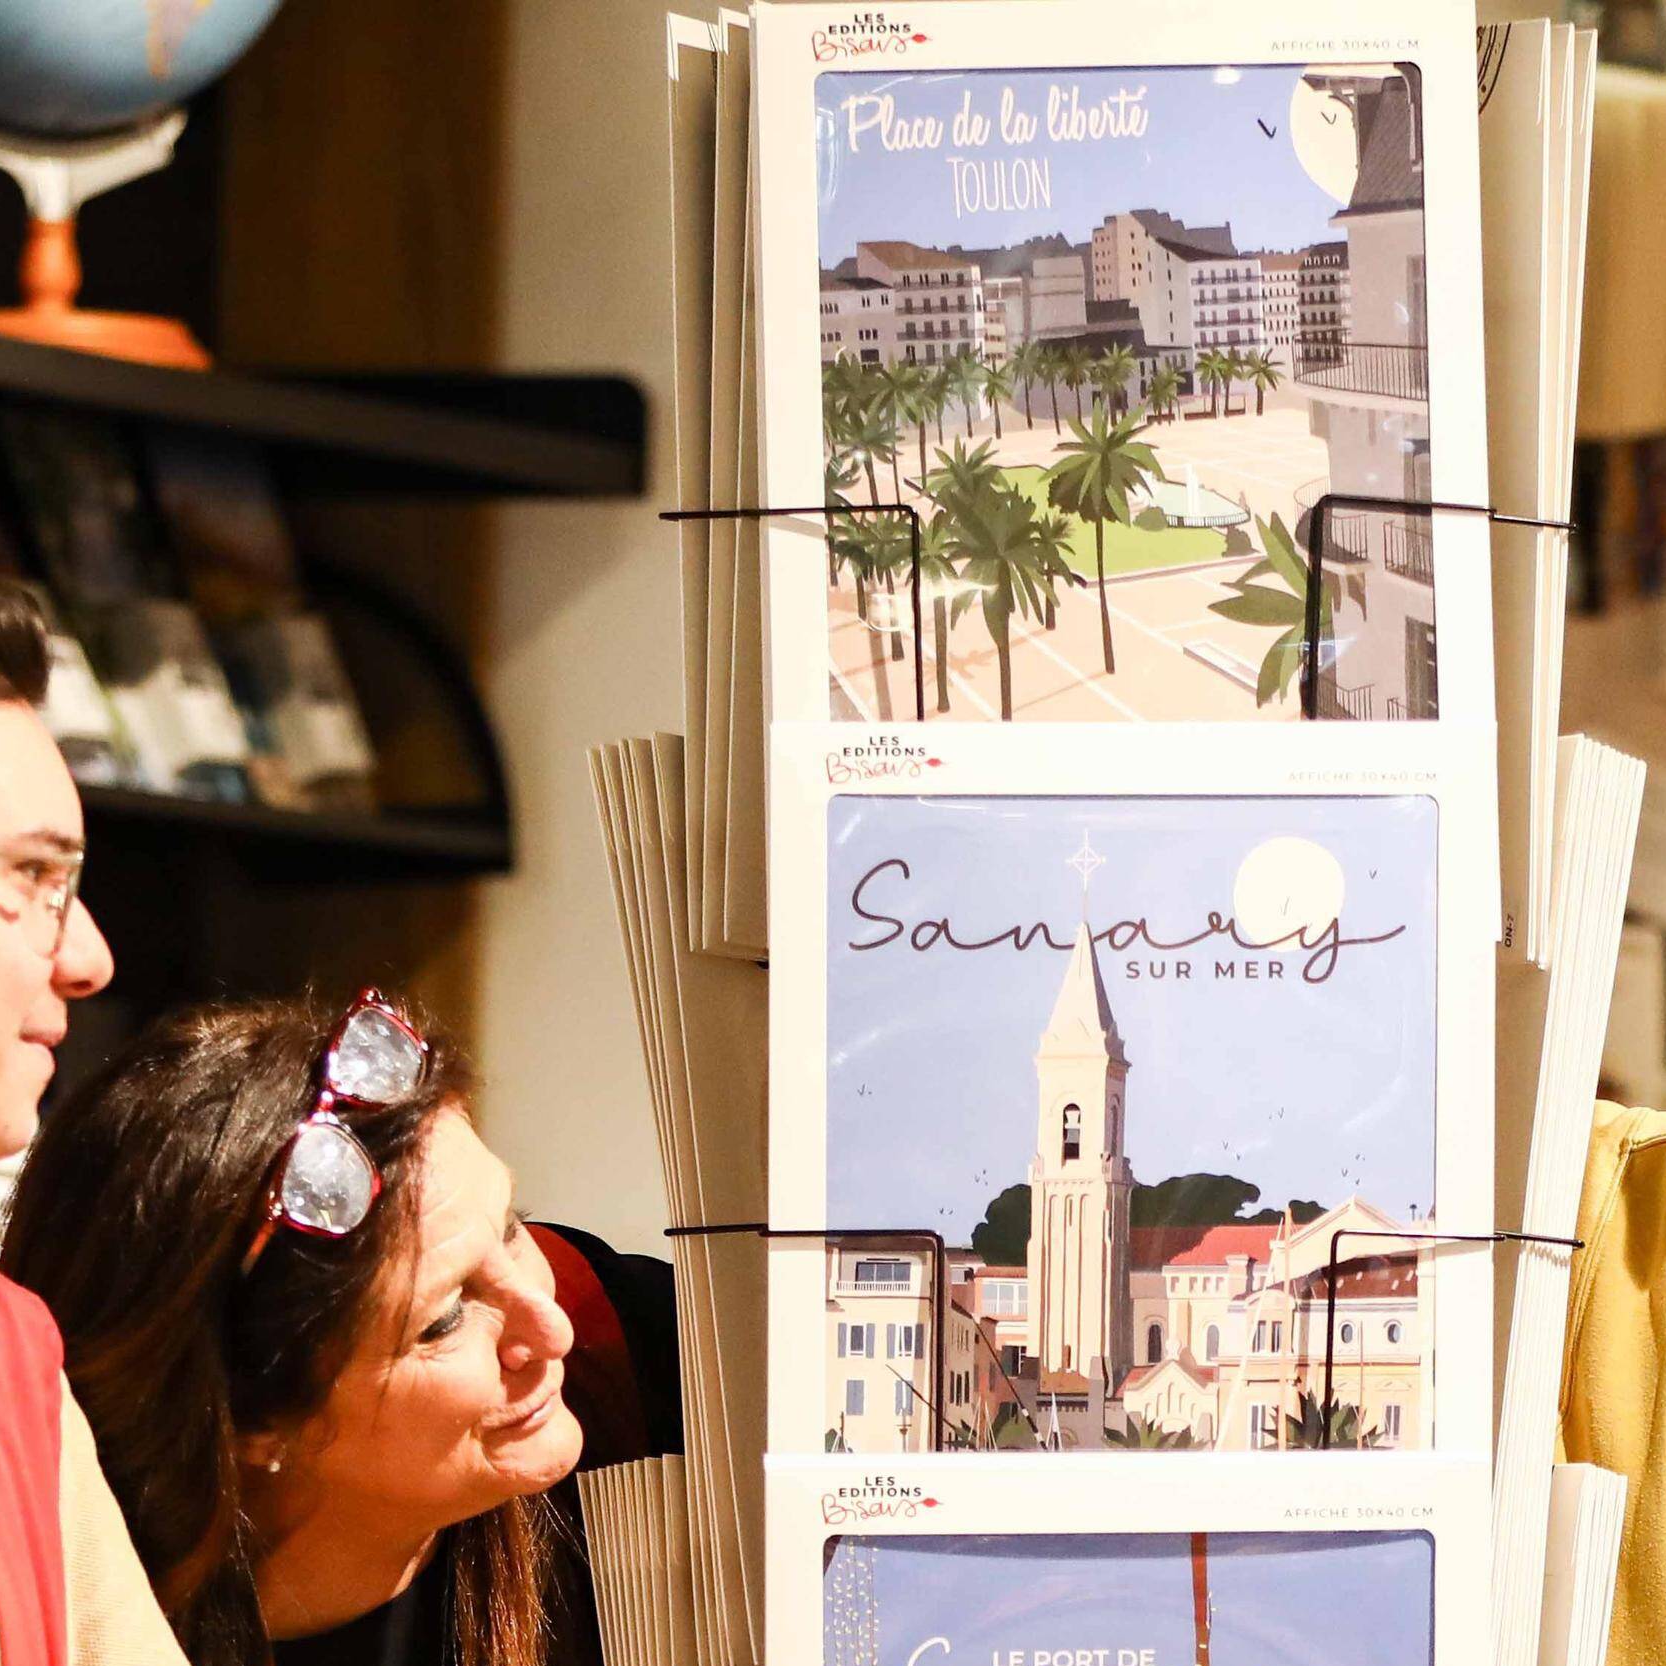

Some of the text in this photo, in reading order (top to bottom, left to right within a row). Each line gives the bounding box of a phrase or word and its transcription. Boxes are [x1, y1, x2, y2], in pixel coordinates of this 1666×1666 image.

[854, 13, 885, 24] LES
[828, 24, 911, 35] EDITIONS
[1271, 40, 1335, 52] AFFICHE
[1397, 39, 1419, 50] CM
[841, 84, 1149, 152] Place de la liberté
[946, 156, 1053, 220] TOULON
[869, 736, 899, 746] LES
[843, 747, 926, 757] EDITIONS
[1288, 771, 1351, 782] AFFICHE
[1414, 771, 1438, 782] CM
[848, 859, 1407, 984] Sanary
[1125, 960, 1286, 979] SUR MER
[865, 1476, 896, 1487] LES
[838, 1487, 922, 1498] EDITIONS
[1284, 1507, 1350, 1519] AFFICHE
[1411, 1507, 1434, 1517] CM
